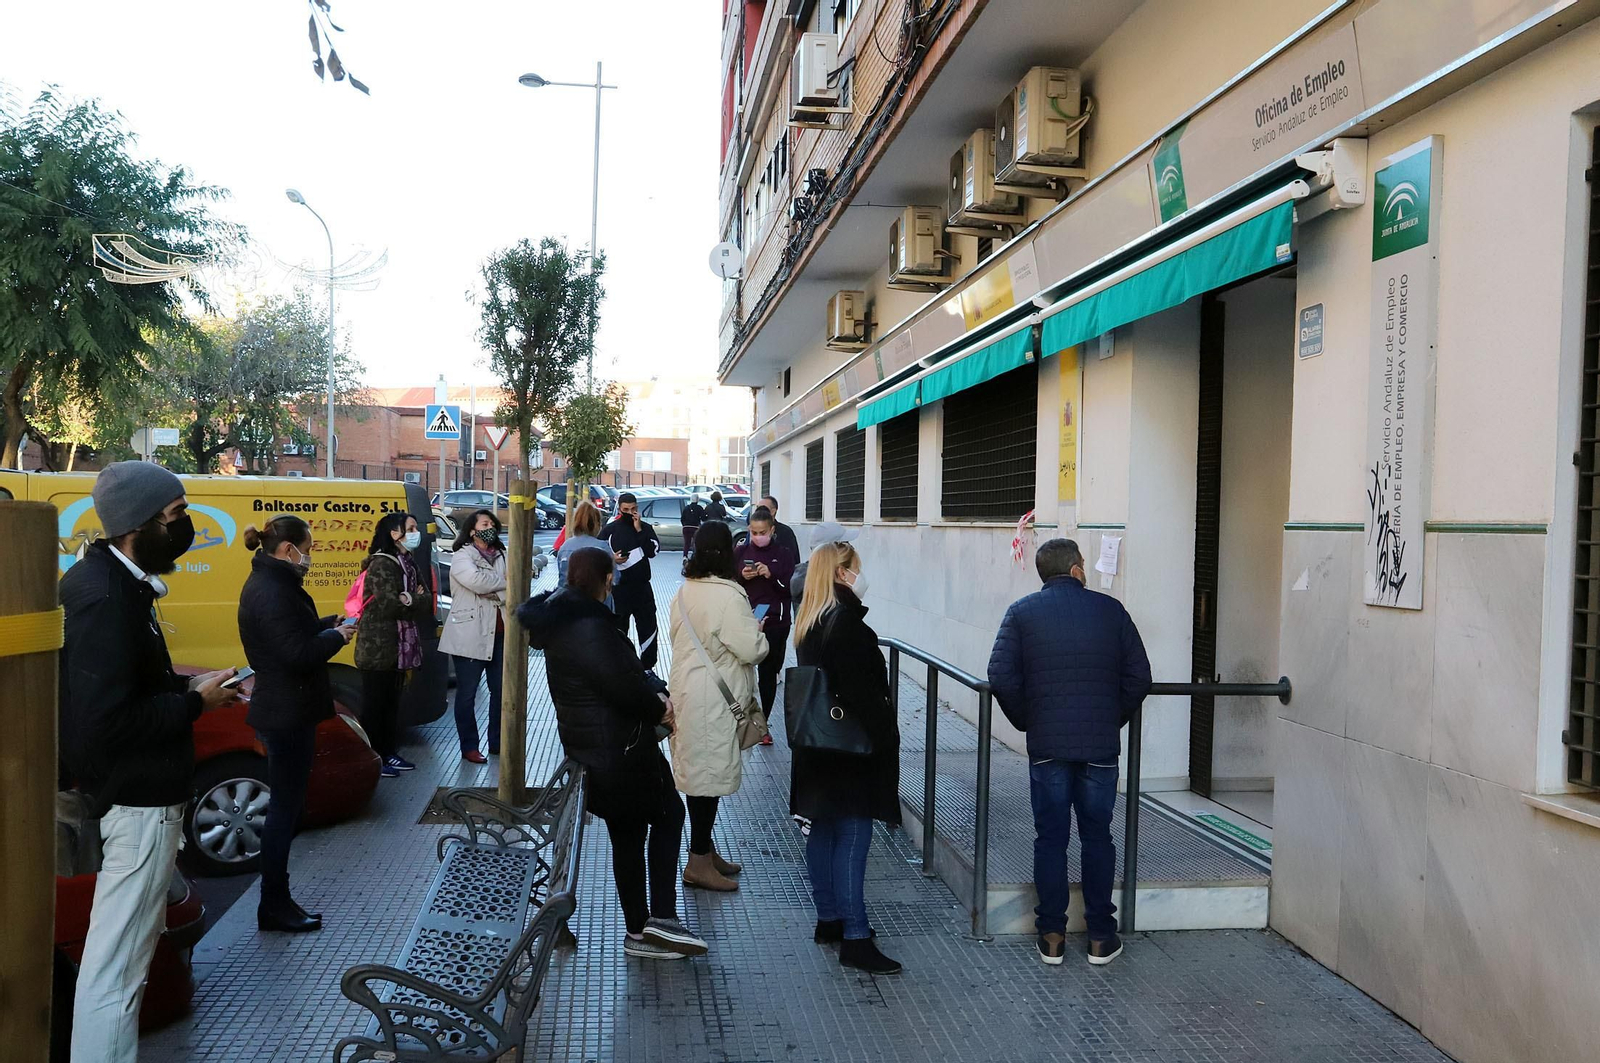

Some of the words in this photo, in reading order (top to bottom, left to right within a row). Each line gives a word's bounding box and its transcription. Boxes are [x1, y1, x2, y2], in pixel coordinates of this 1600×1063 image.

[1252, 129, 1276, 151] Servicio
[1279, 110, 1307, 136] Andaluz
[1308, 104, 1317, 118] de
[1320, 85, 1348, 111] Empleo
[1255, 97, 1288, 128] Oficina
[1290, 85, 1303, 106] de
[1304, 60, 1345, 97] Empleo
[1381, 227, 1392, 237] JUNTA
[1393, 224, 1398, 233] DE
[1386, 277, 1397, 330] Empleo
[1399, 274, 1409, 345] COMERCIO
[1385, 335, 1394, 352] de
[1398, 349, 1406, 357] Y
[1383, 357, 1393, 413] Andaluz
[1396, 359, 1406, 420] EMPRESA
[1382, 417, 1392, 470] Servicio
[1394, 423, 1405, 480] EMPLEO,
[253, 499, 318, 512] Baltasar
[324, 500, 375, 514] Castro,
[380, 501, 405, 513] S.L.
[1394, 483, 1401, 501] DE
[186, 562, 210, 574] lujo
[325, 570, 345, 578] Baja)
